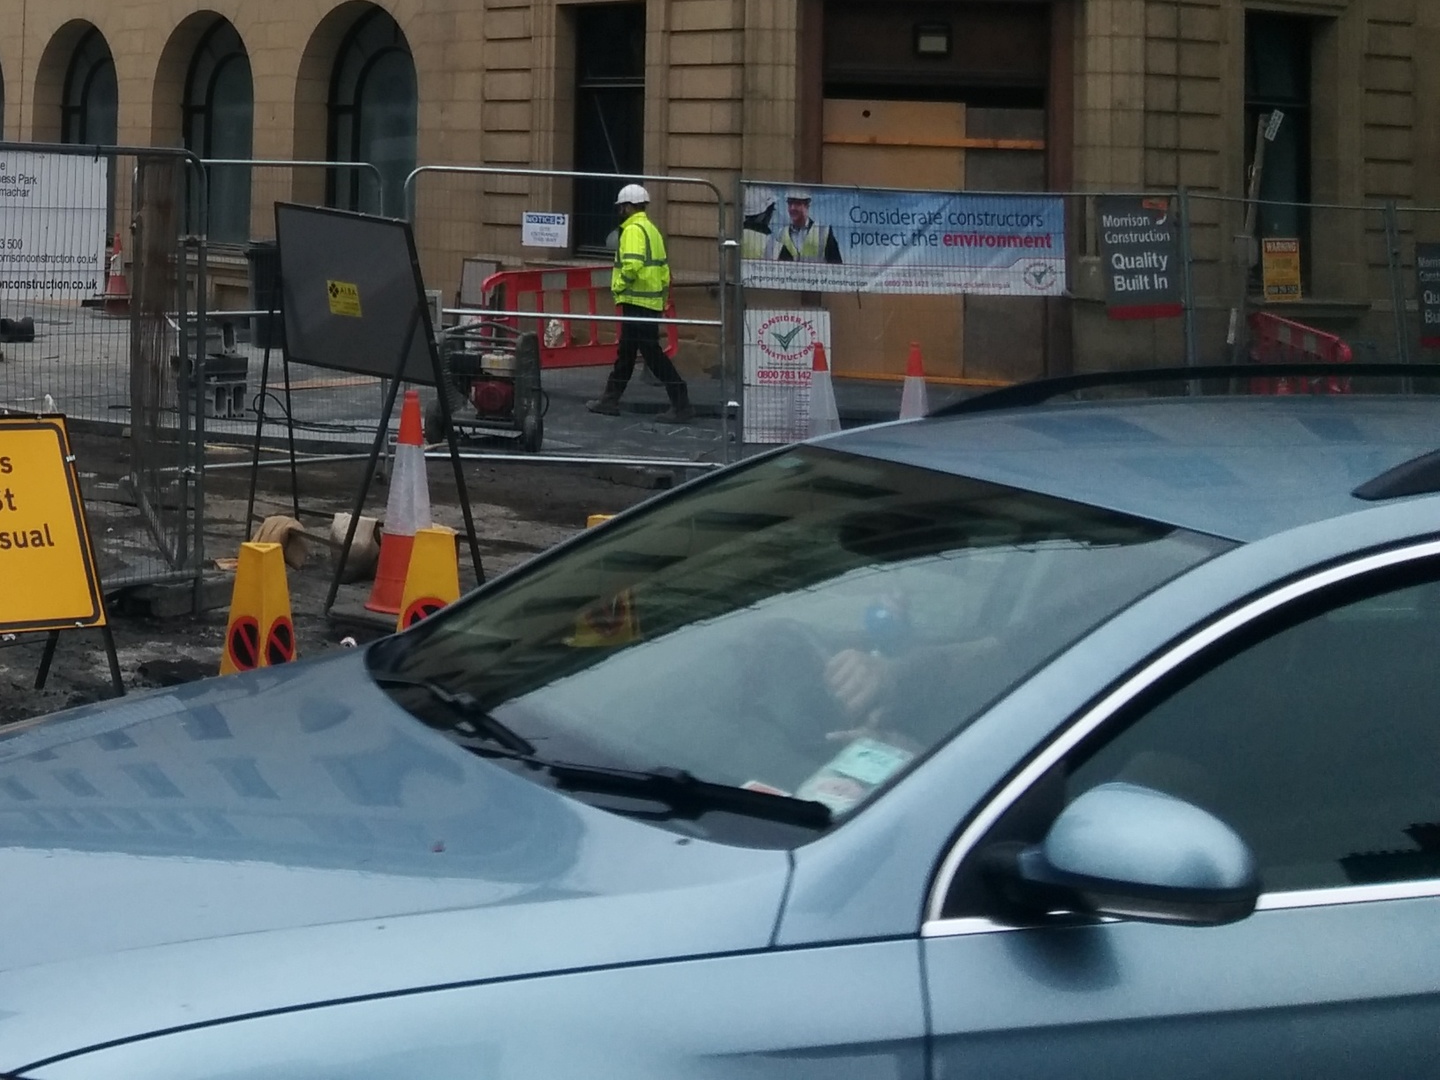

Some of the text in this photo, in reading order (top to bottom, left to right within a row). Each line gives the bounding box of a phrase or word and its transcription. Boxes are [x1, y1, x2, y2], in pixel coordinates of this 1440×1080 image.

[19, 174, 38, 185] Park
[526, 215, 555, 224] NOTICE
[849, 206, 1043, 228] Considerate constructors
[1102, 214, 1150, 227] Morrison
[850, 230, 1052, 248] protect the environment
[1105, 229, 1170, 244] Construction
[7, 239, 23, 250] 500
[1266, 241, 1297, 252] WARNING
[1112, 252, 1168, 271] Quality
[1114, 273, 1168, 291] Built In
[758, 315, 816, 336] CONSIDERATE
[757, 340, 816, 361] CONSTRUCTOR
[757, 370, 778, 379] 0800
[780, 370, 795, 380] 783
